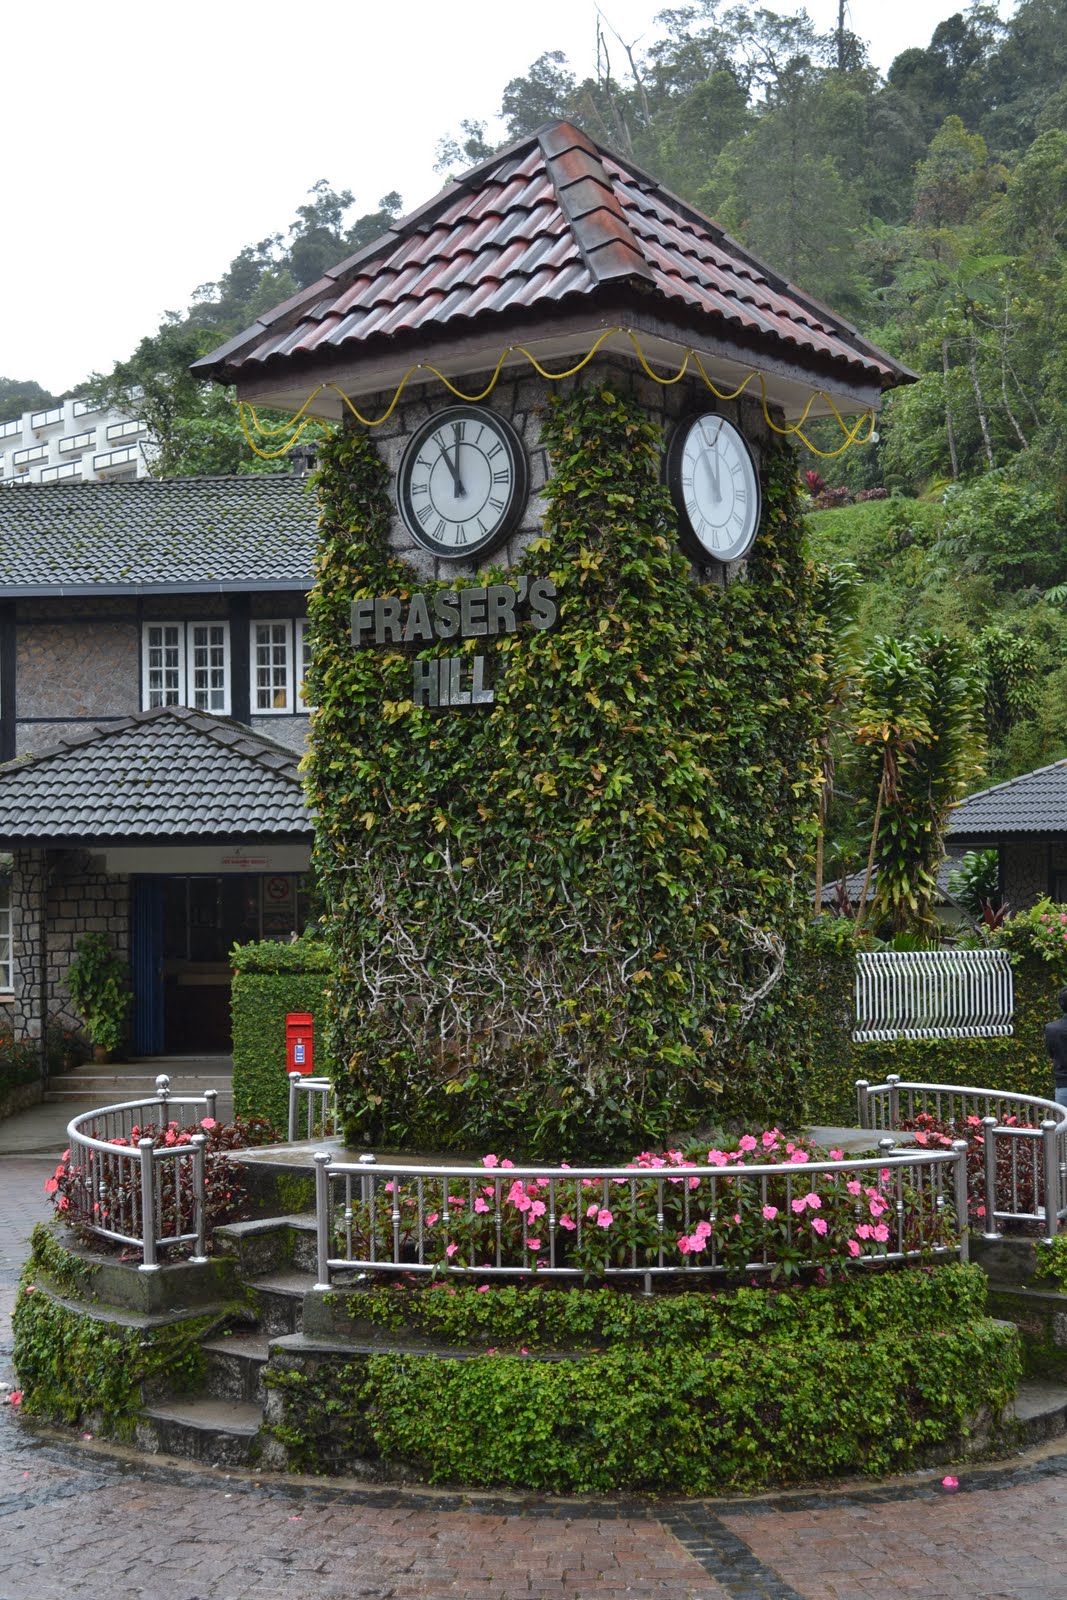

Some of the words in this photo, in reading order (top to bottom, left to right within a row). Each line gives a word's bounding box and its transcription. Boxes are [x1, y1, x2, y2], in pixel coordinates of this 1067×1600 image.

[475, 425, 485, 444] I
[487, 441, 503, 460] II
[416, 455, 432, 469] X
[494, 468, 509, 484] III
[412, 483, 428, 496] IX
[416, 504, 434, 526] VIII
[489, 497, 504, 514] IV
[432, 519, 446, 541] VII
[455, 525, 468, 544] VI
[477, 517, 488, 536] V
[350, 576, 557, 647] FRASER'S
[413, 655, 494, 707] HILL
